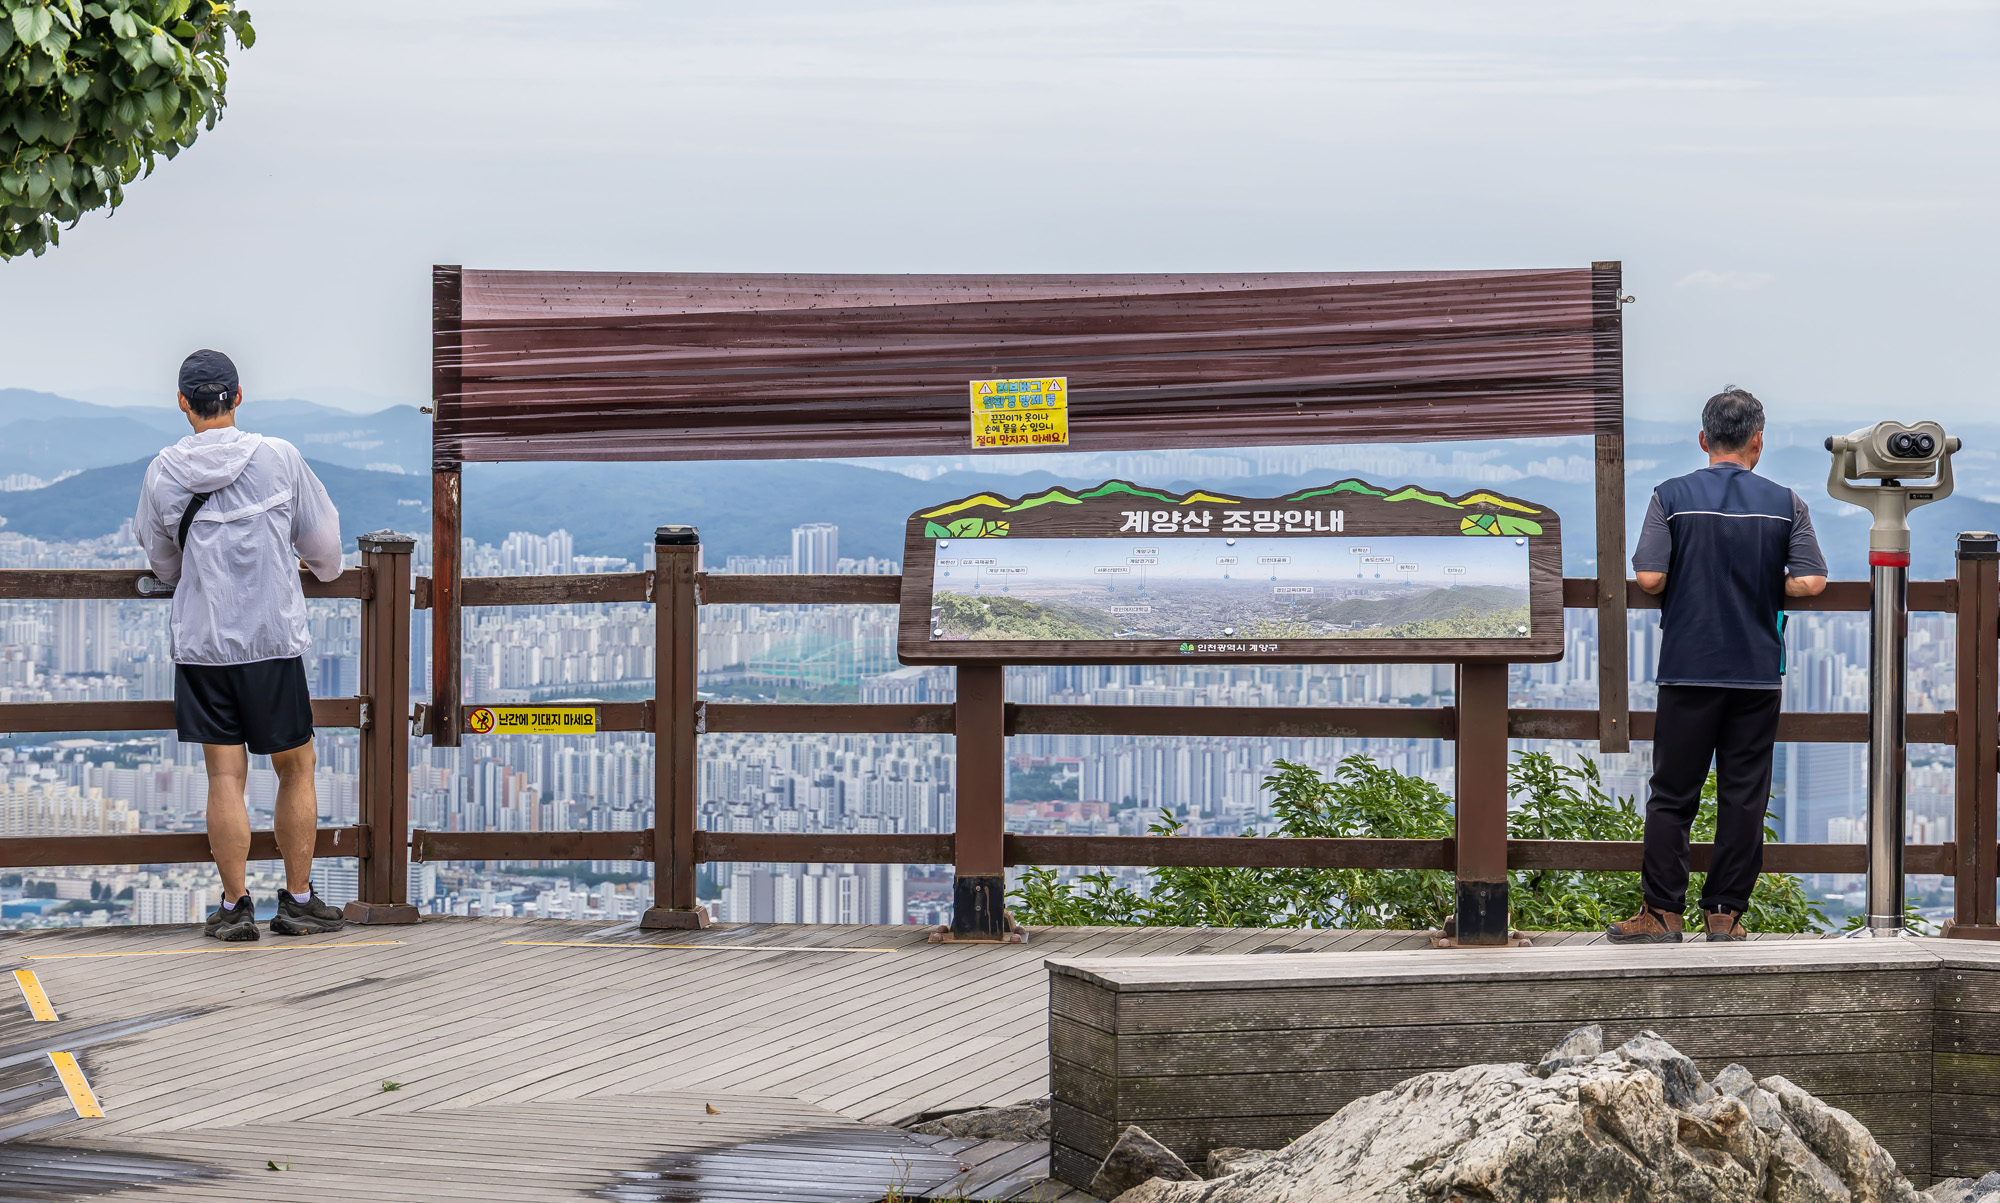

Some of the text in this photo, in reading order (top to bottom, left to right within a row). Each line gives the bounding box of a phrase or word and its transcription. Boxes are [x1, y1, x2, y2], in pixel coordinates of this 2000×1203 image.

[991, 413, 1049, 424] 끈끈이가 옷이나
[985, 423, 1054, 434] 손에 묻을 수 있으니
[976, 432, 1066, 446] 절대 만지지 마세요!
[1119, 510, 1344, 533] 계양산 조망안내
[1197, 643, 1278, 653] 인천광역시 계양구
[498, 713, 593, 726] 난간에 기대지 마세요
